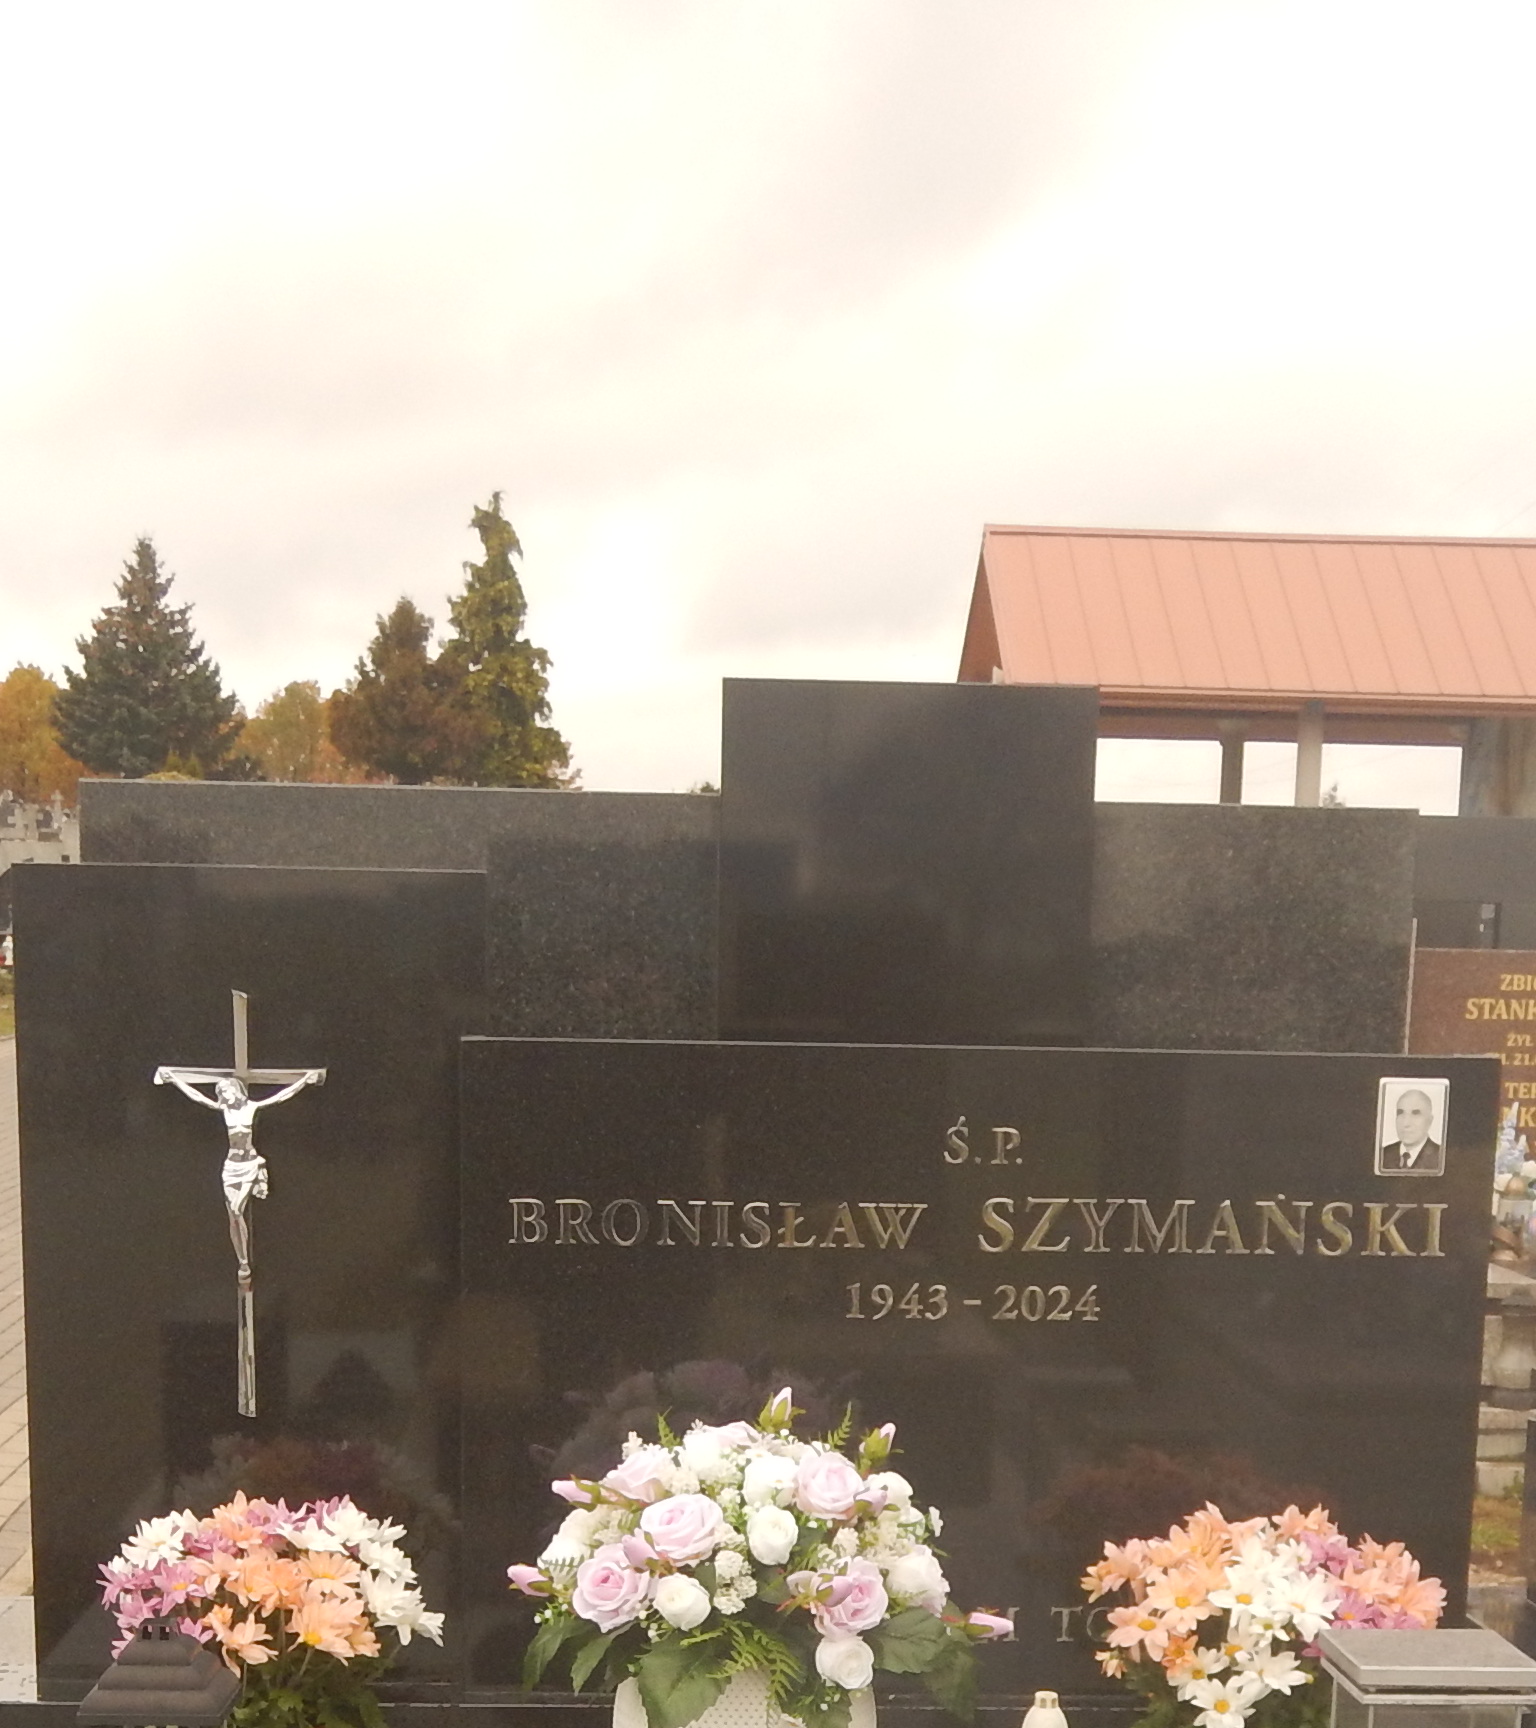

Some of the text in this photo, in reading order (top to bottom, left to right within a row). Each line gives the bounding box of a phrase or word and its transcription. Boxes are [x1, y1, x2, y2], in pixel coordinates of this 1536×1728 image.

[1507, 1032, 1533, 1047] ŻYŁ
[944, 1117, 1024, 1164] Ś.P.
[508, 1192, 1447, 1259] BRONISŁAW SZYMAŃSKI
[846, 1282, 950, 1321] 1943
[992, 1283, 1102, 1323] 2024
